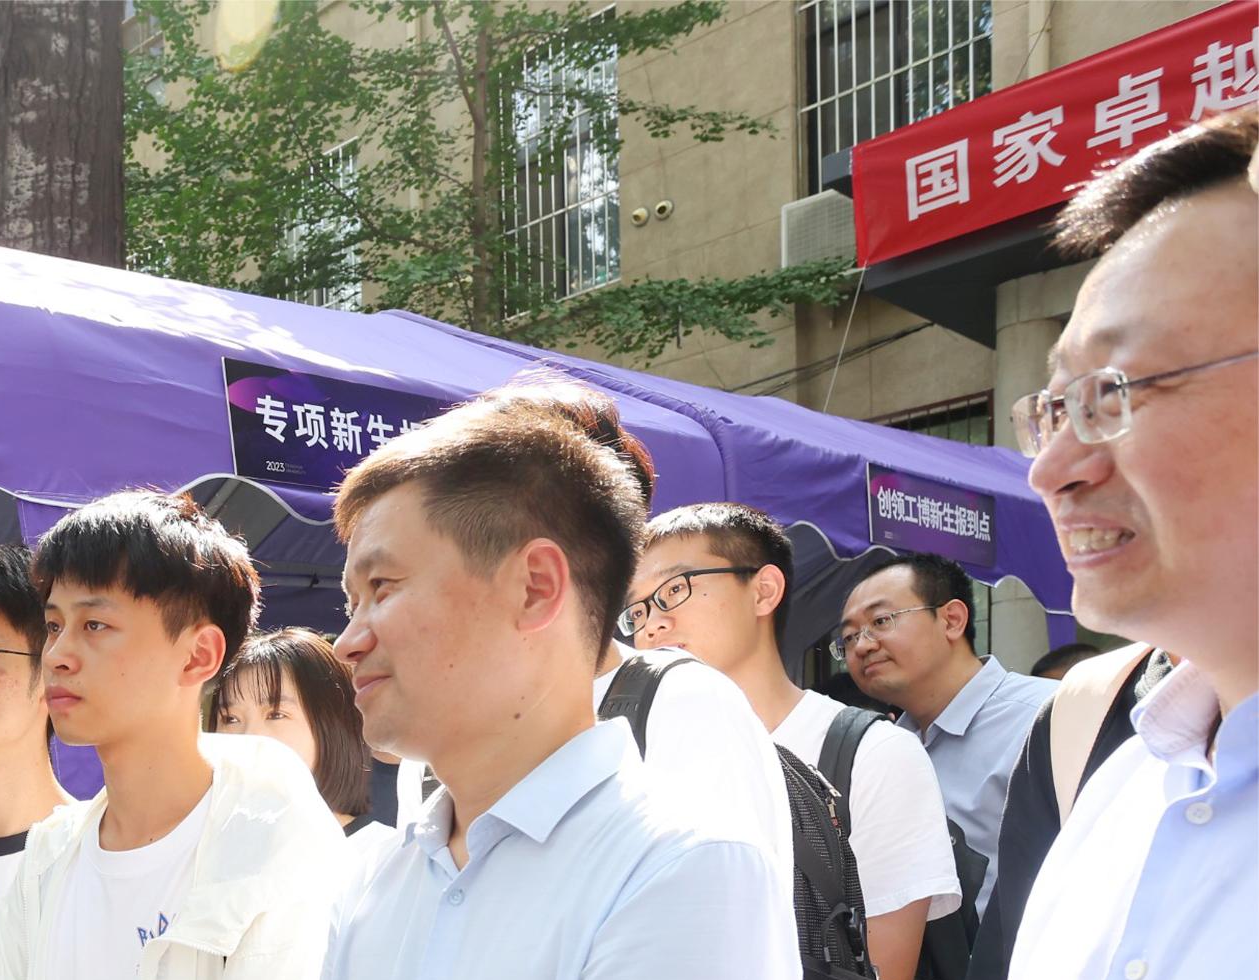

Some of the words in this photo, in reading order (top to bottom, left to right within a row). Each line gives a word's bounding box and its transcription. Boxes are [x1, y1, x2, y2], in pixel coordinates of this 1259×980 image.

[255, 394, 423, 456] 专项新生
[265, 460, 286, 473] 2023
[877, 485, 991, 542] 创领工博新生报到点
